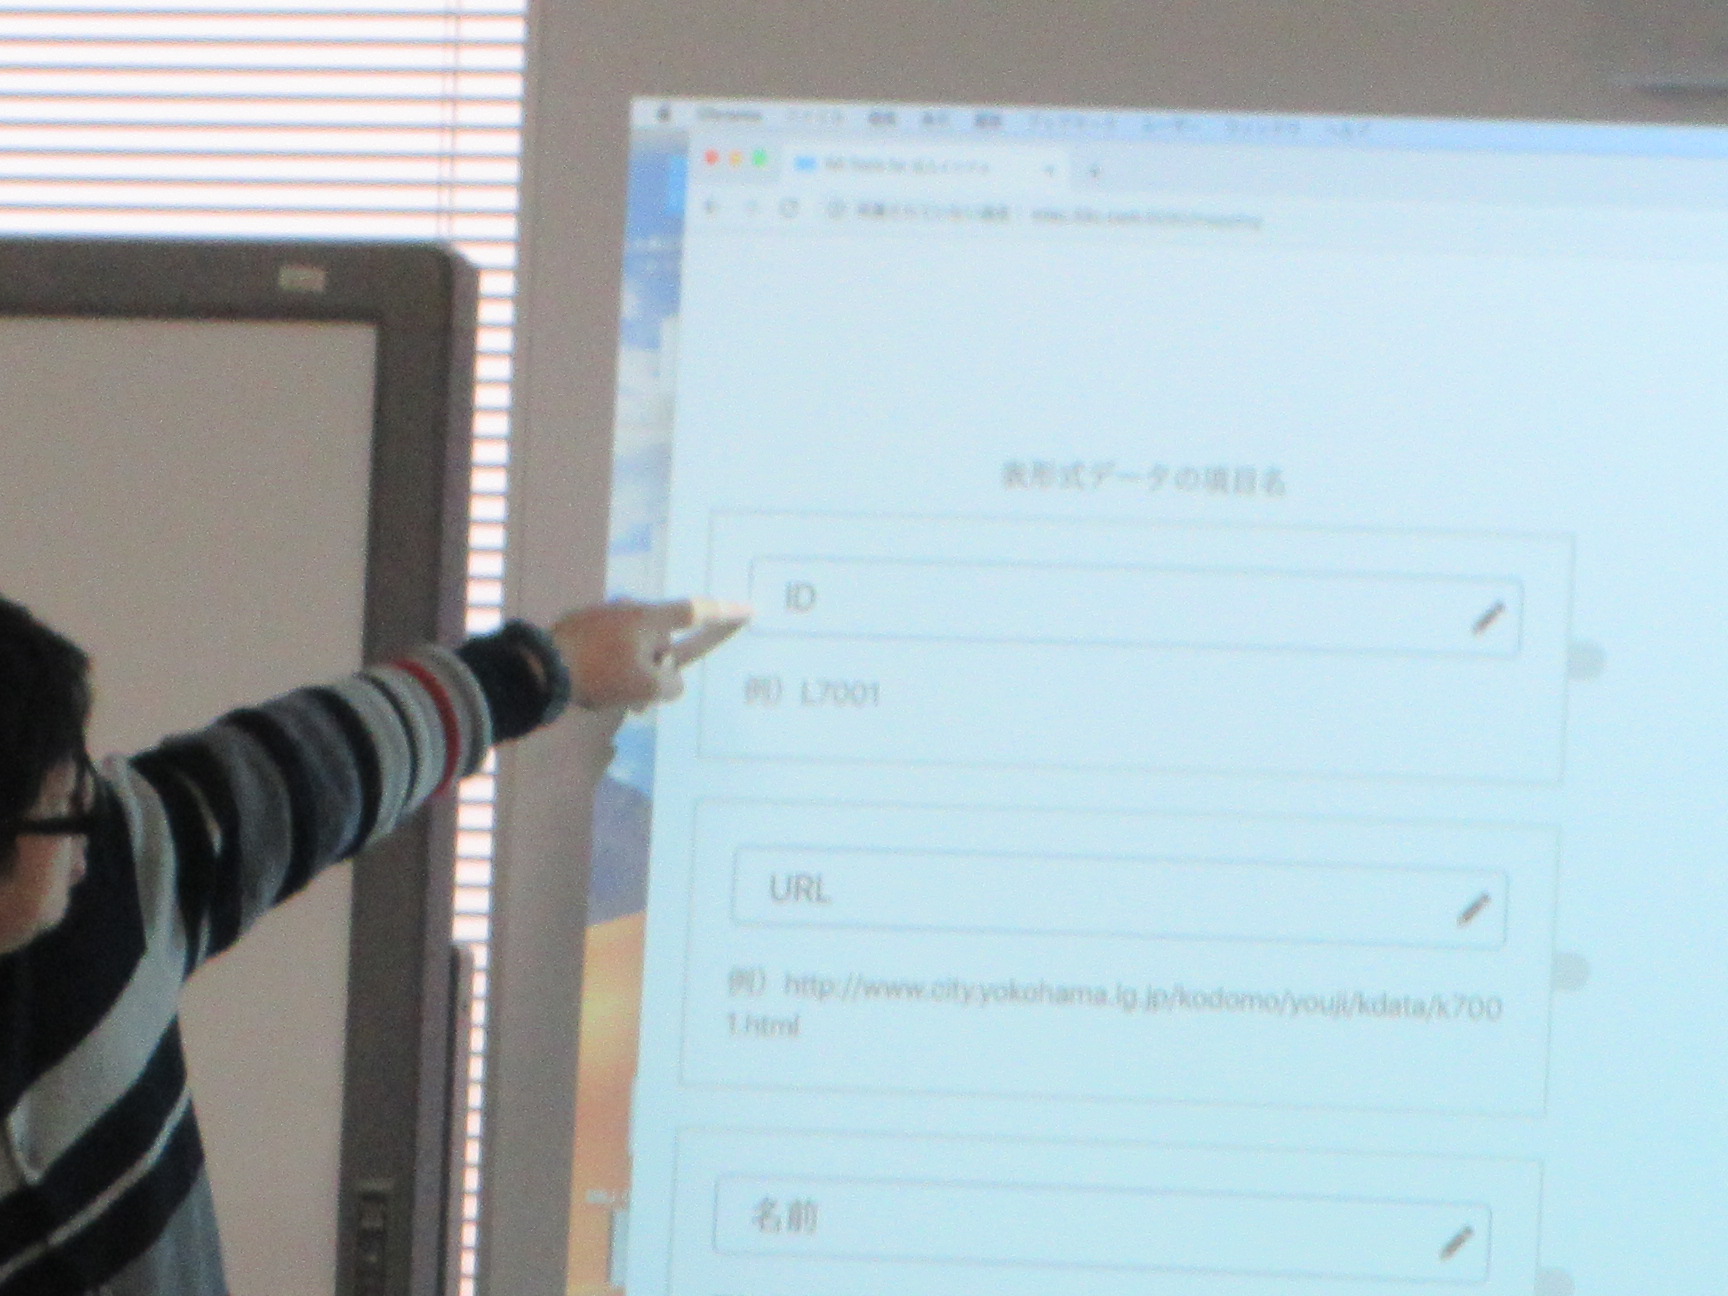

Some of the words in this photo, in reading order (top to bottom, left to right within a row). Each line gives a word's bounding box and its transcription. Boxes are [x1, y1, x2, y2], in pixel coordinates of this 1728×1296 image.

[999, 458, 1288, 501] 表形式データの項目名
[783, 581, 818, 616] ID
[768, 871, 835, 908] URL
[749, 1194, 821, 1240] 名前
